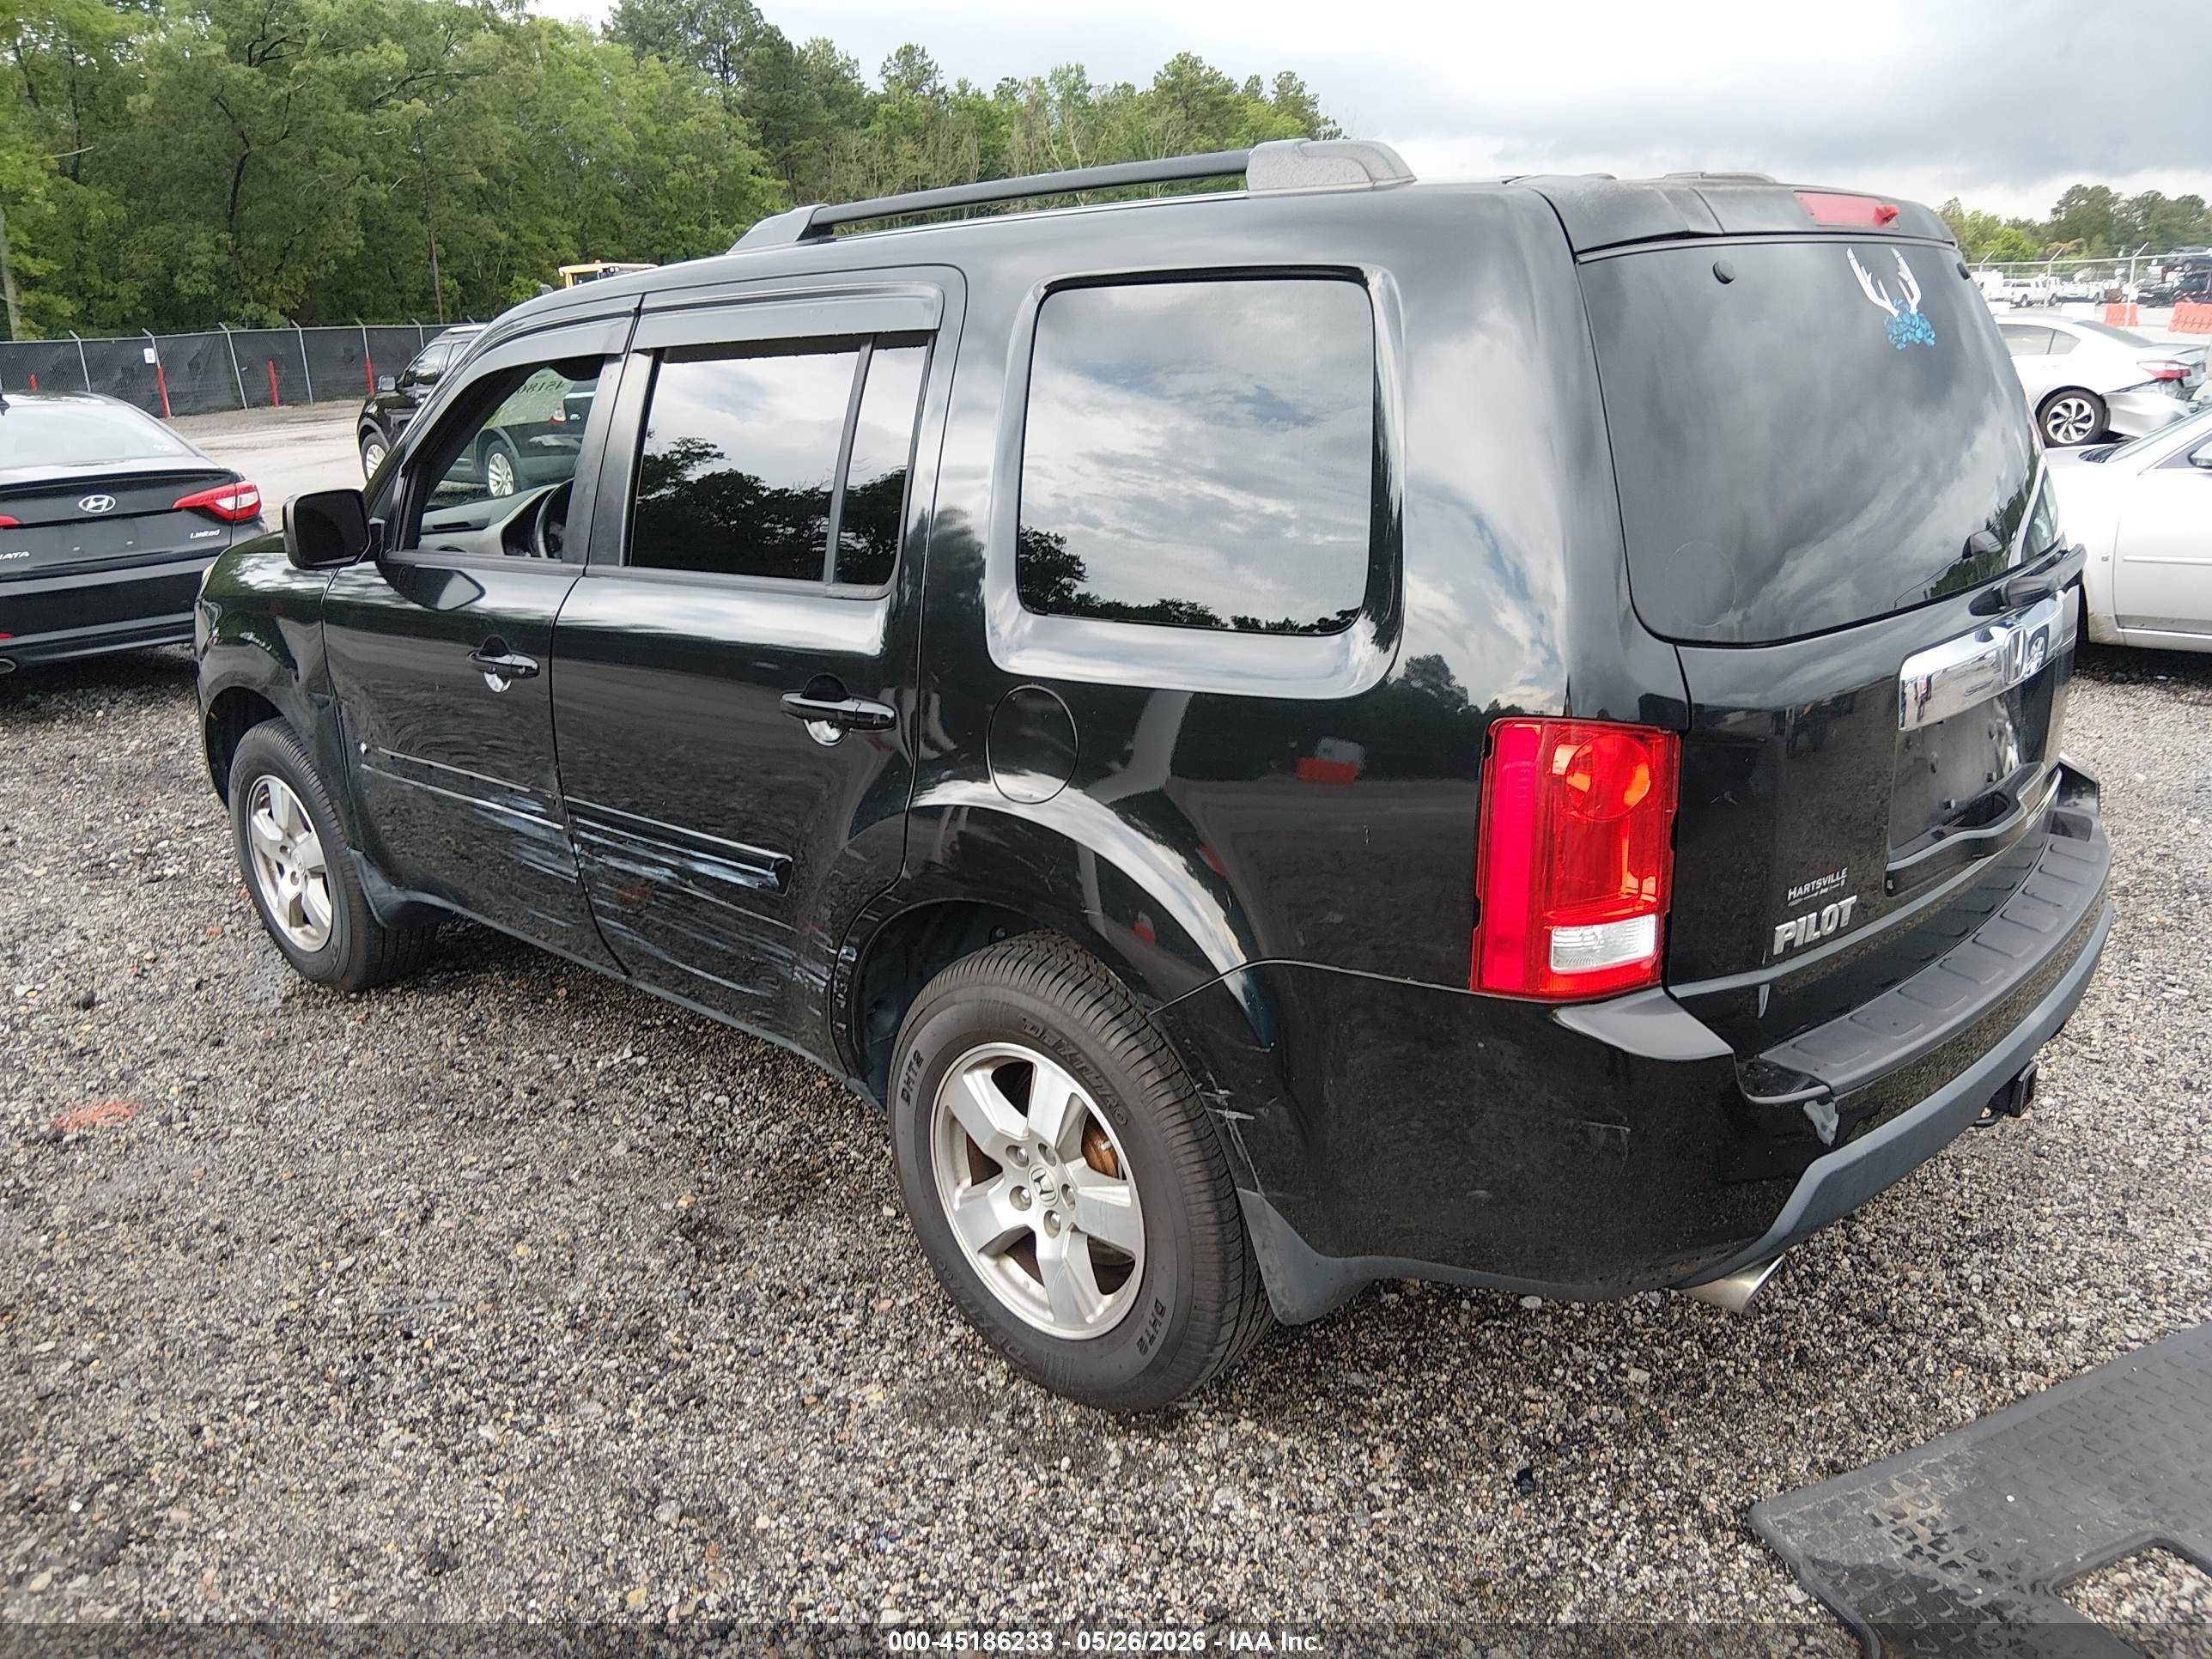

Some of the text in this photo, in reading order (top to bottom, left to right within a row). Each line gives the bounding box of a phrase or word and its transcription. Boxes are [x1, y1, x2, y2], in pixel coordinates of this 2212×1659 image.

[1787, 866, 1848, 901] HARTSVILLE
[1772, 895, 1857, 955] PILOT
[901, 1049, 925, 1106] DHT2
[1136, 1297, 1167, 1355] DHT2
